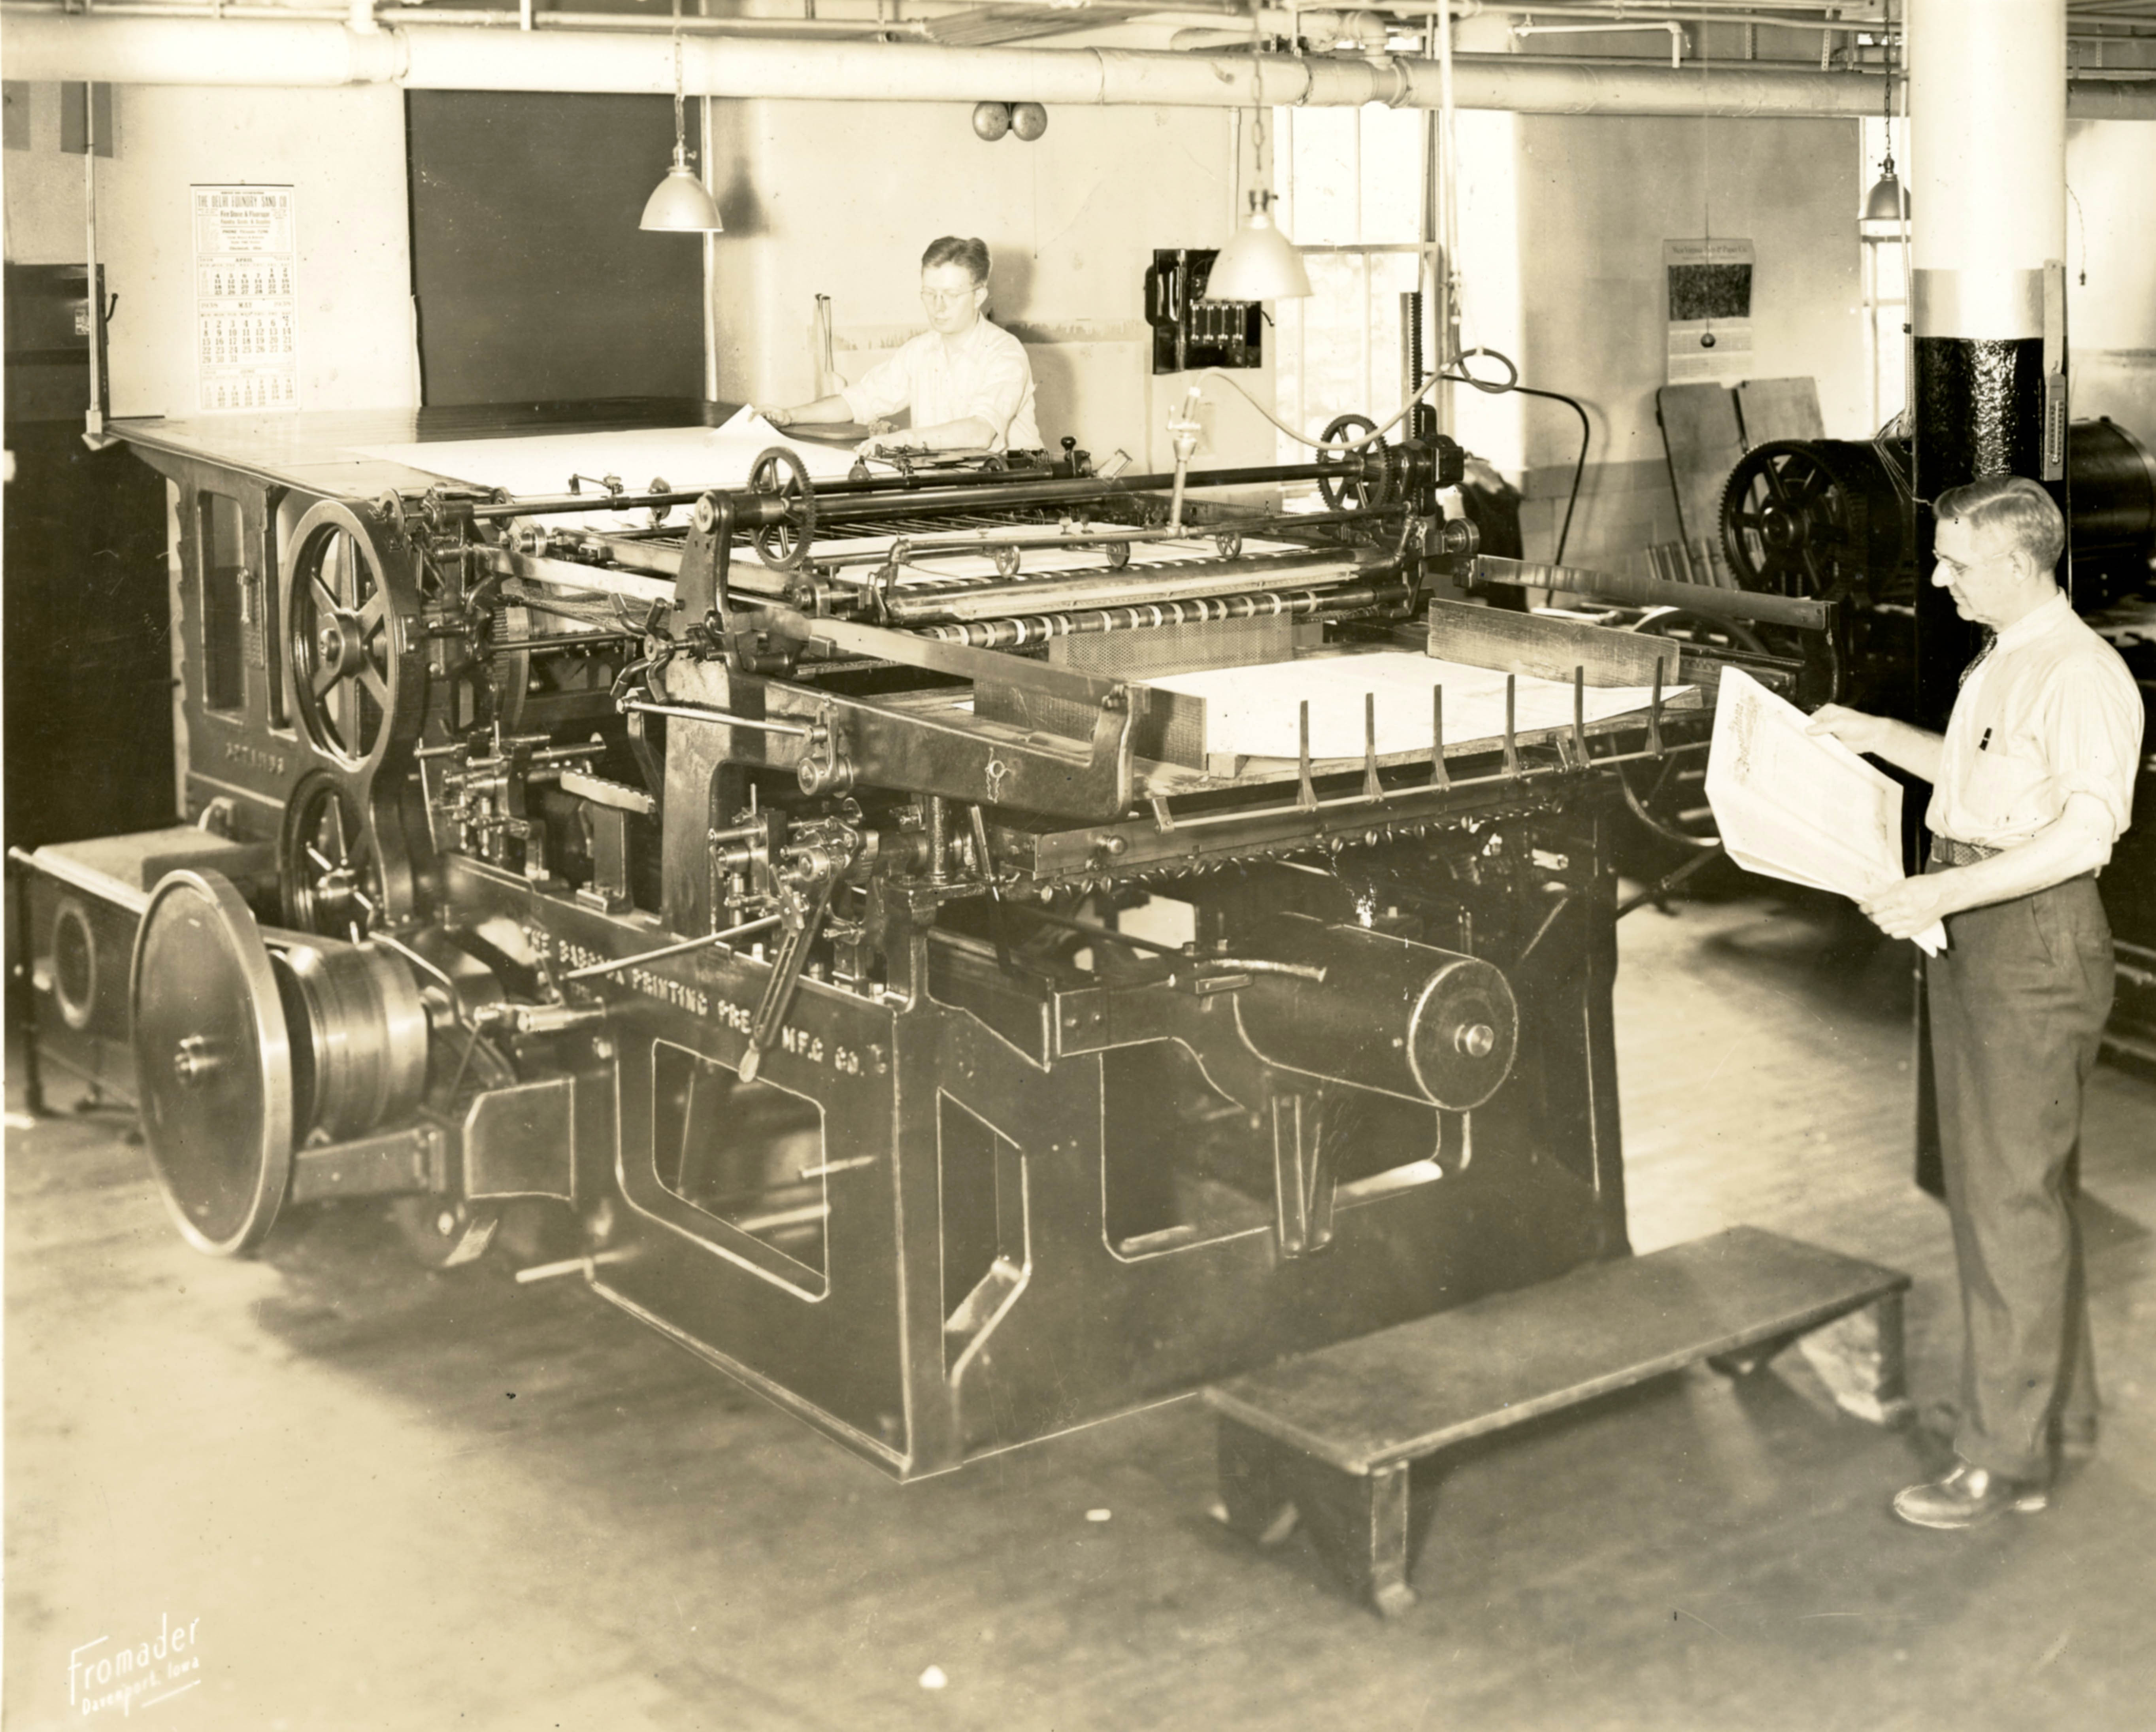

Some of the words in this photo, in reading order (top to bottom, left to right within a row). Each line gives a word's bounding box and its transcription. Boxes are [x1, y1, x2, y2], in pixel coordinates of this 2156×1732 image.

[198, 195, 208, 208] THE
[232, 195, 257, 208] FOUNDRY
[261, 196, 276, 208] SAND
[631, 968, 708, 1016] PRINTING
[717, 999, 752, 1034] PRE
